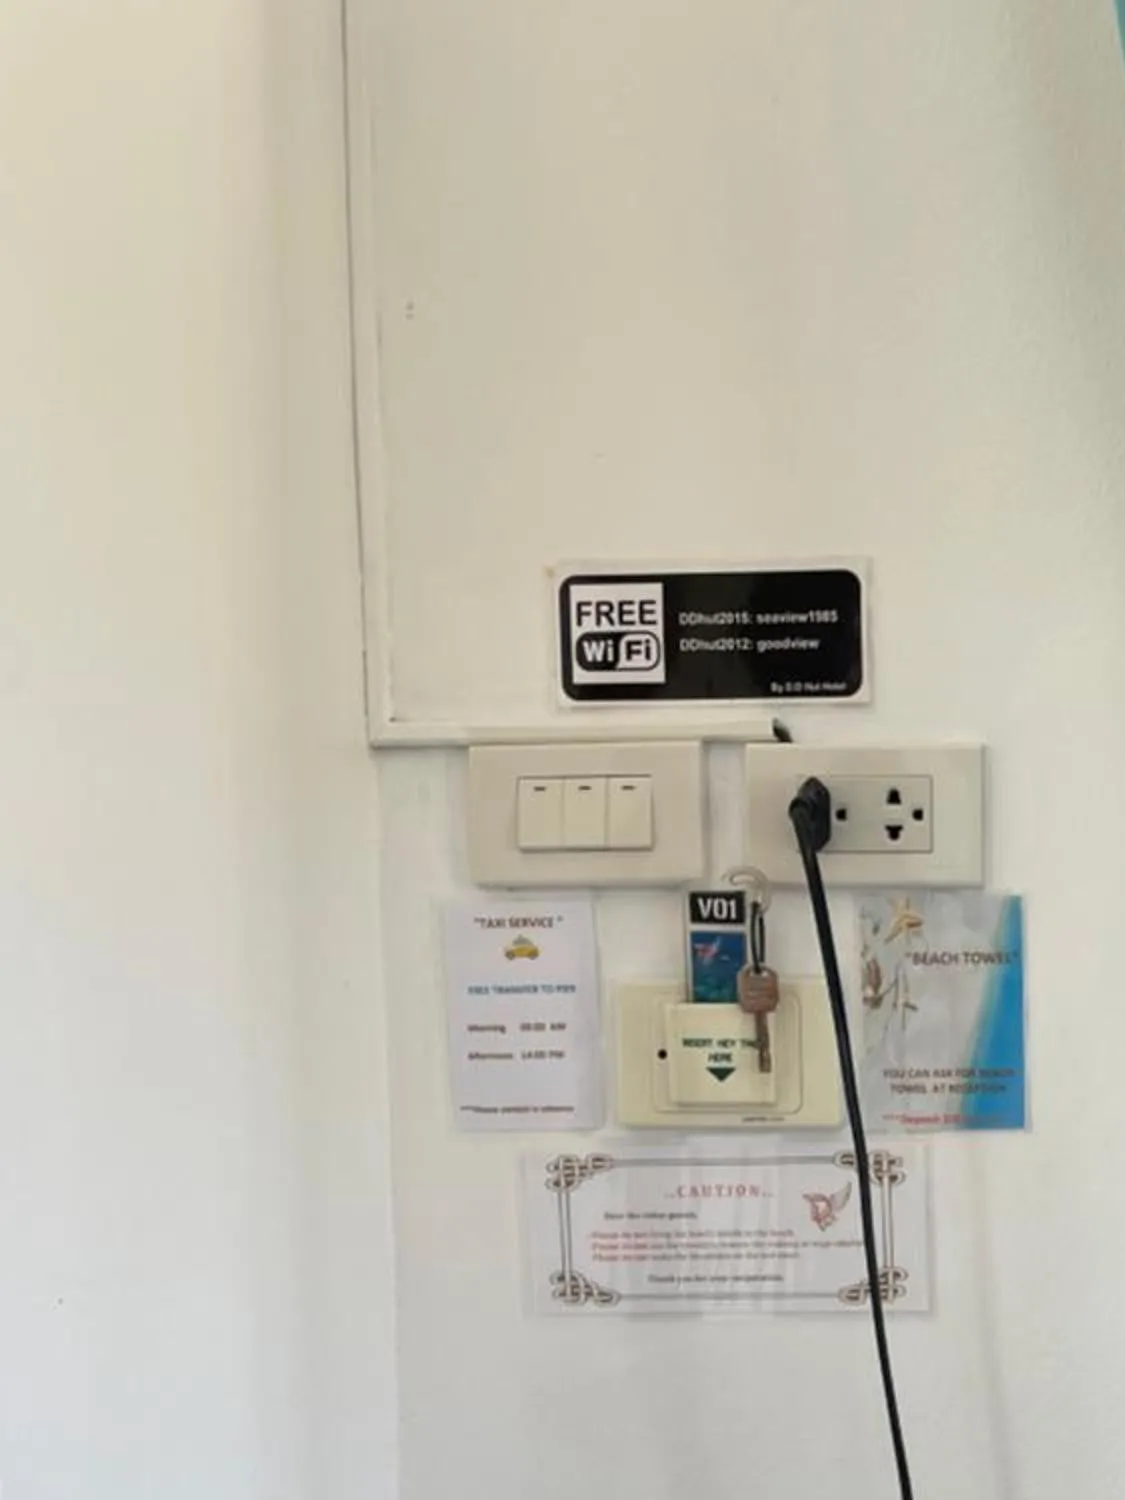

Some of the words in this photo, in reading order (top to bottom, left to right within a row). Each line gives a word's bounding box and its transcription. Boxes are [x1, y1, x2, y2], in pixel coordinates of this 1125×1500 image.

[575, 600, 657, 627] FREE
[756, 638, 820, 652] goodview
[698, 898, 738, 919] V01
[509, 917, 553, 928] SERVICE
[708, 1053, 733, 1063] HERE
